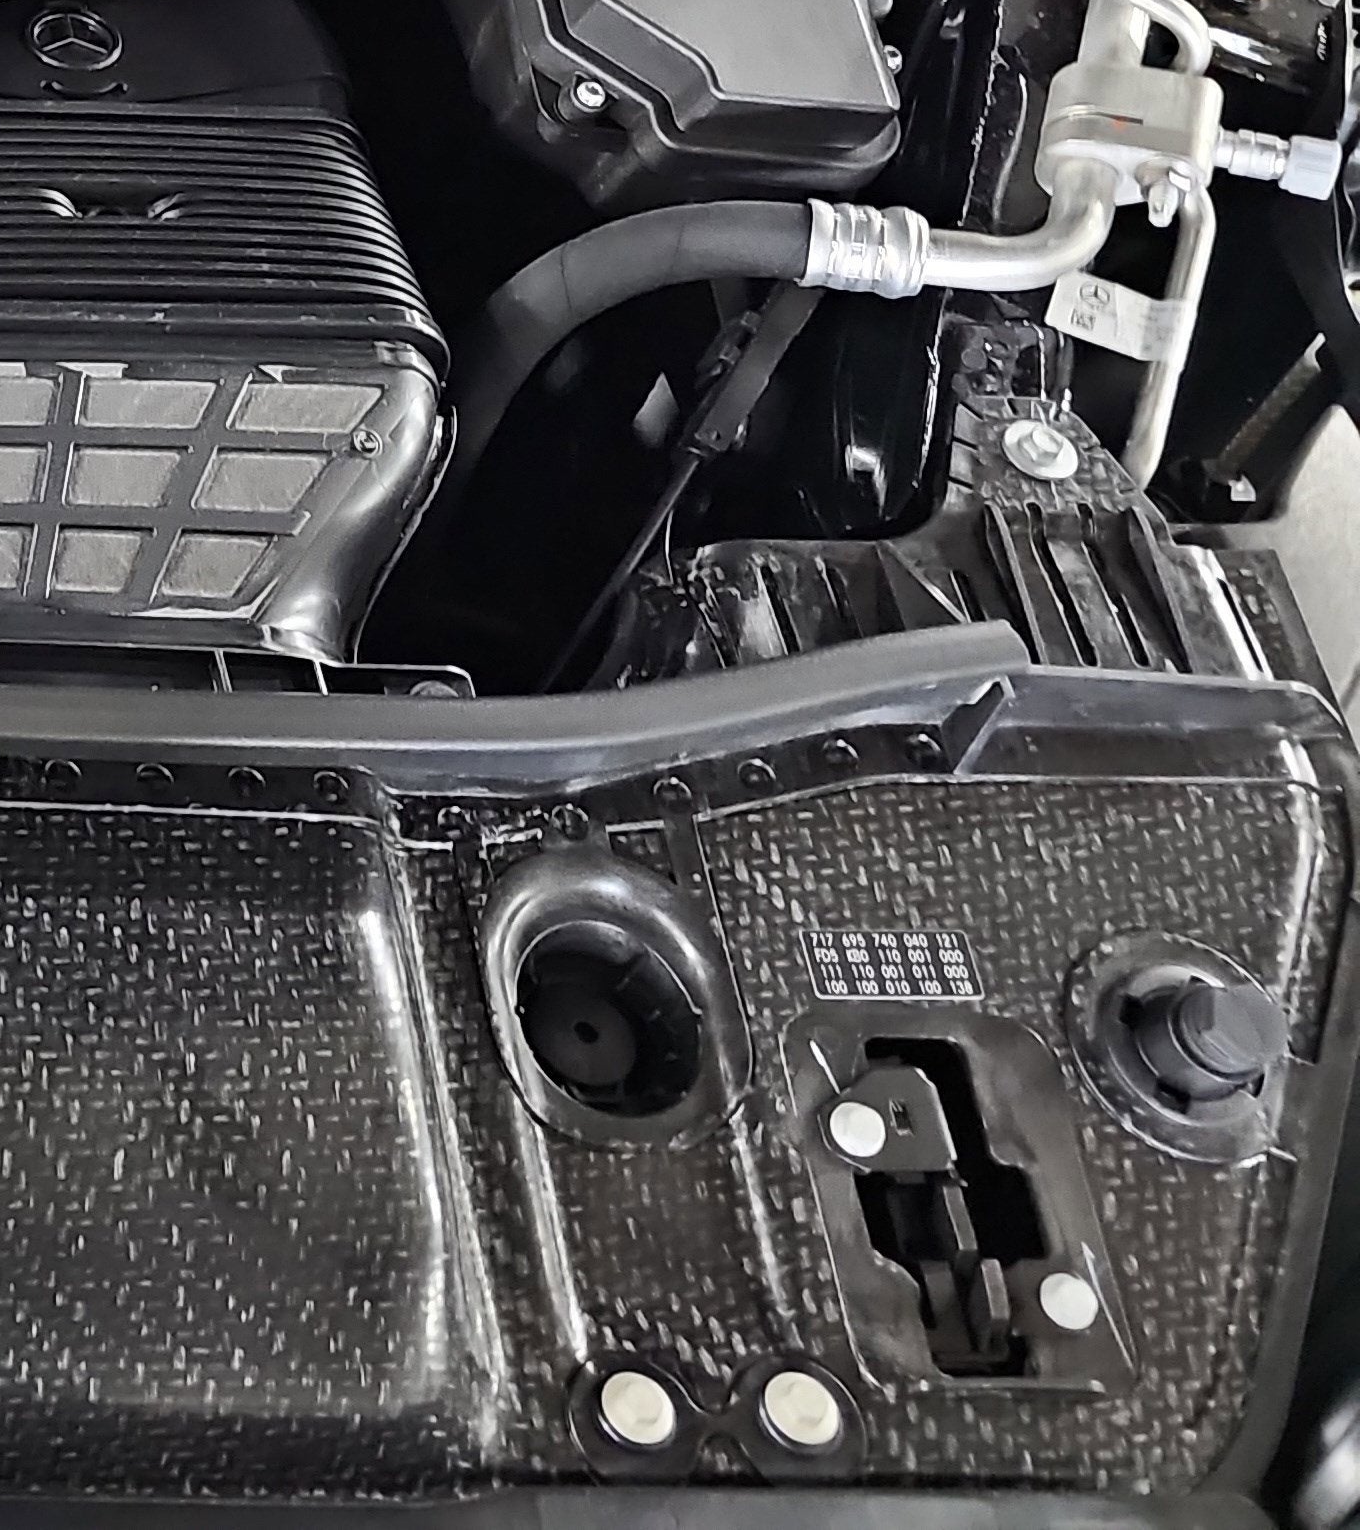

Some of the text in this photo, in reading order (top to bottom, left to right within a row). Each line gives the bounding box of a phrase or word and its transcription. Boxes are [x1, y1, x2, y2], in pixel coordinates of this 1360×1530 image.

[809, 932, 959, 948] 717 695 740 040 121
[877, 948, 902, 964] 110
[907, 948, 932, 964] 001
[938, 948, 965, 964] 000
[820, 963, 969, 980] 111 110 001 011 000
[824, 979, 849, 995] 100
[855, 979, 880, 995] 100
[885, 979, 911, 995] 010
[918, 979, 942, 995] 100
